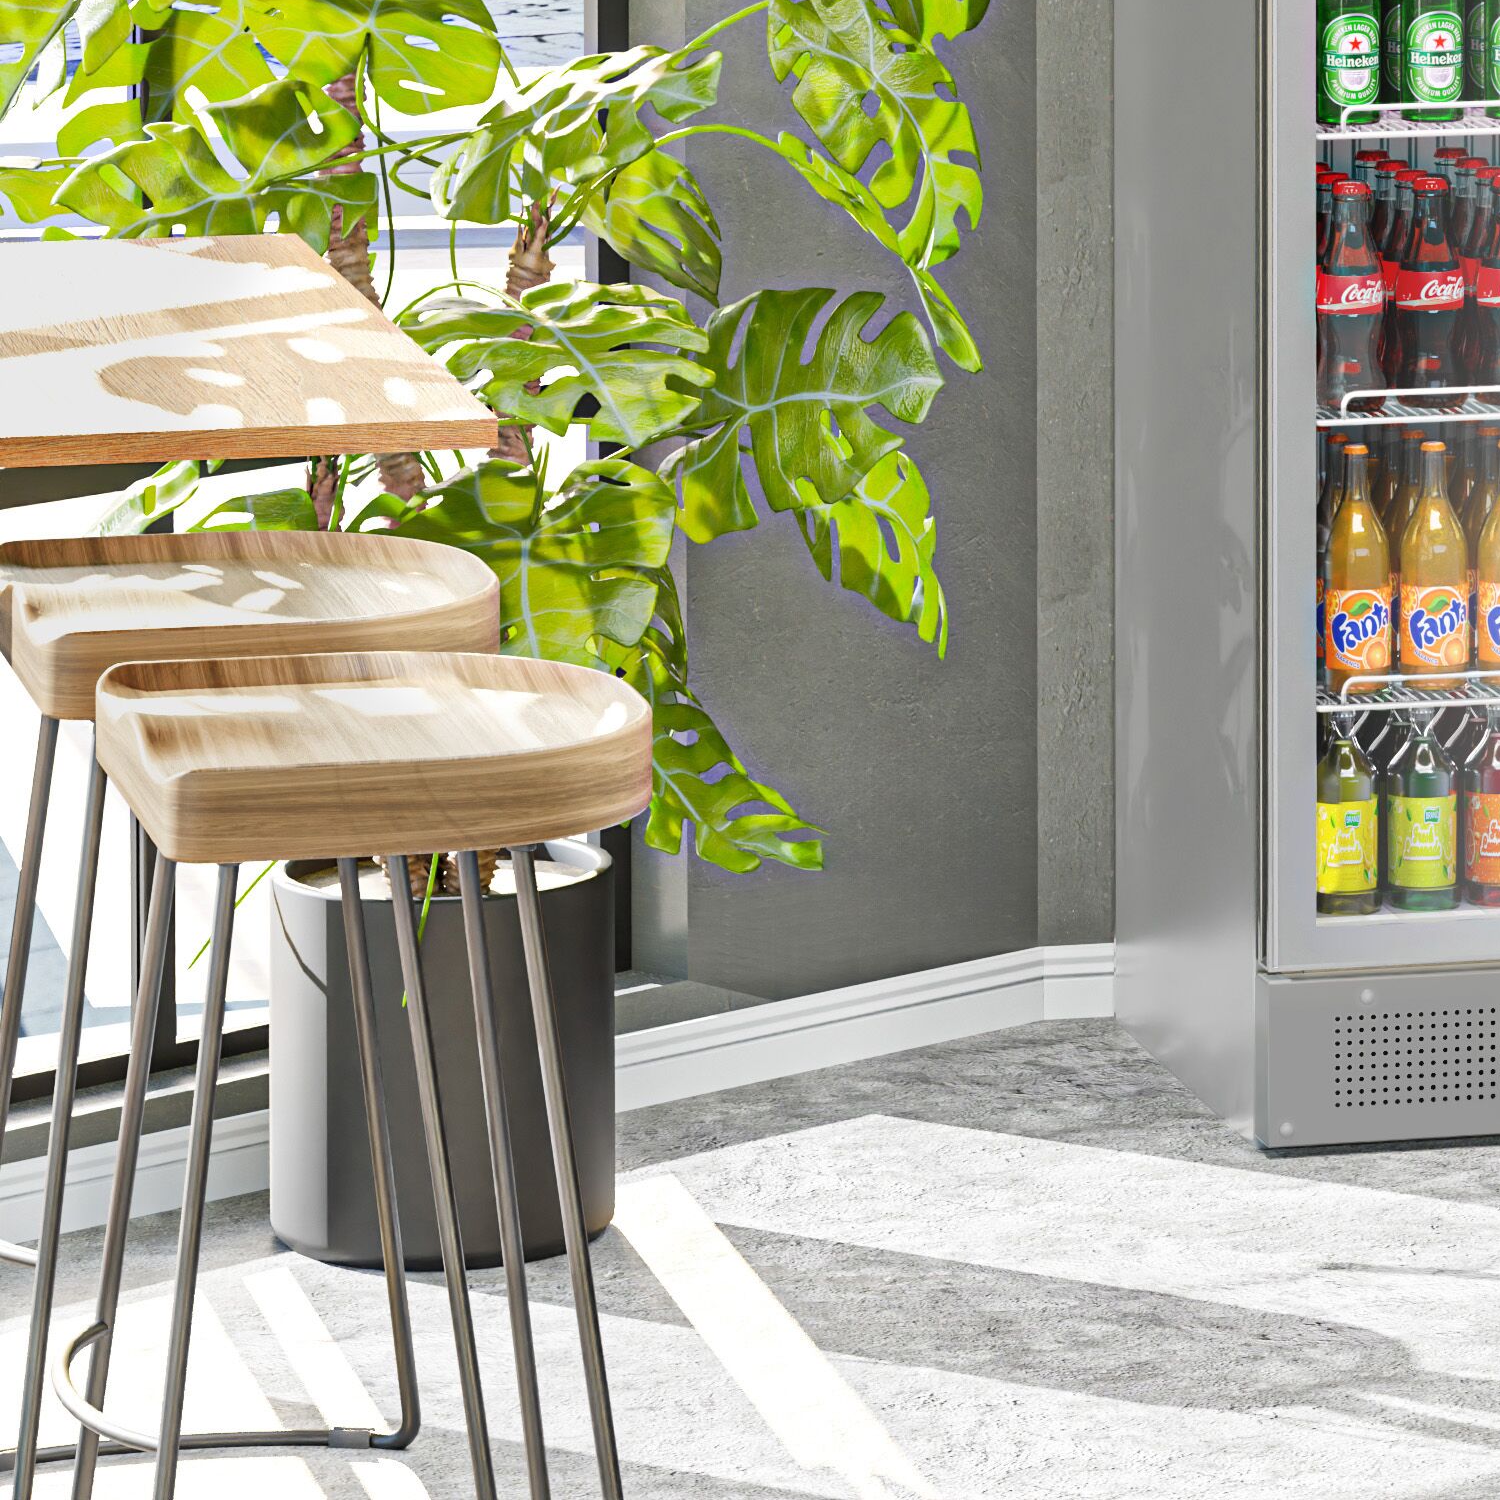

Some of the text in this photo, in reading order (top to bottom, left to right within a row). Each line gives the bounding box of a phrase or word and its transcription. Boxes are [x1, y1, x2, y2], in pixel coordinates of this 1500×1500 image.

[1354, 24, 1370, 34] LAGER
[1438, 22, 1454, 31] LAGER
[1326, 54, 1379, 68] Heineken
[1331, 78, 1377, 99] PREMIUM QUALITY
[1415, 76, 1461, 96] PREMIUM QUALITY
[1331, 602, 1388, 653] Fanta
[1409, 598, 1466, 650] Fanta
